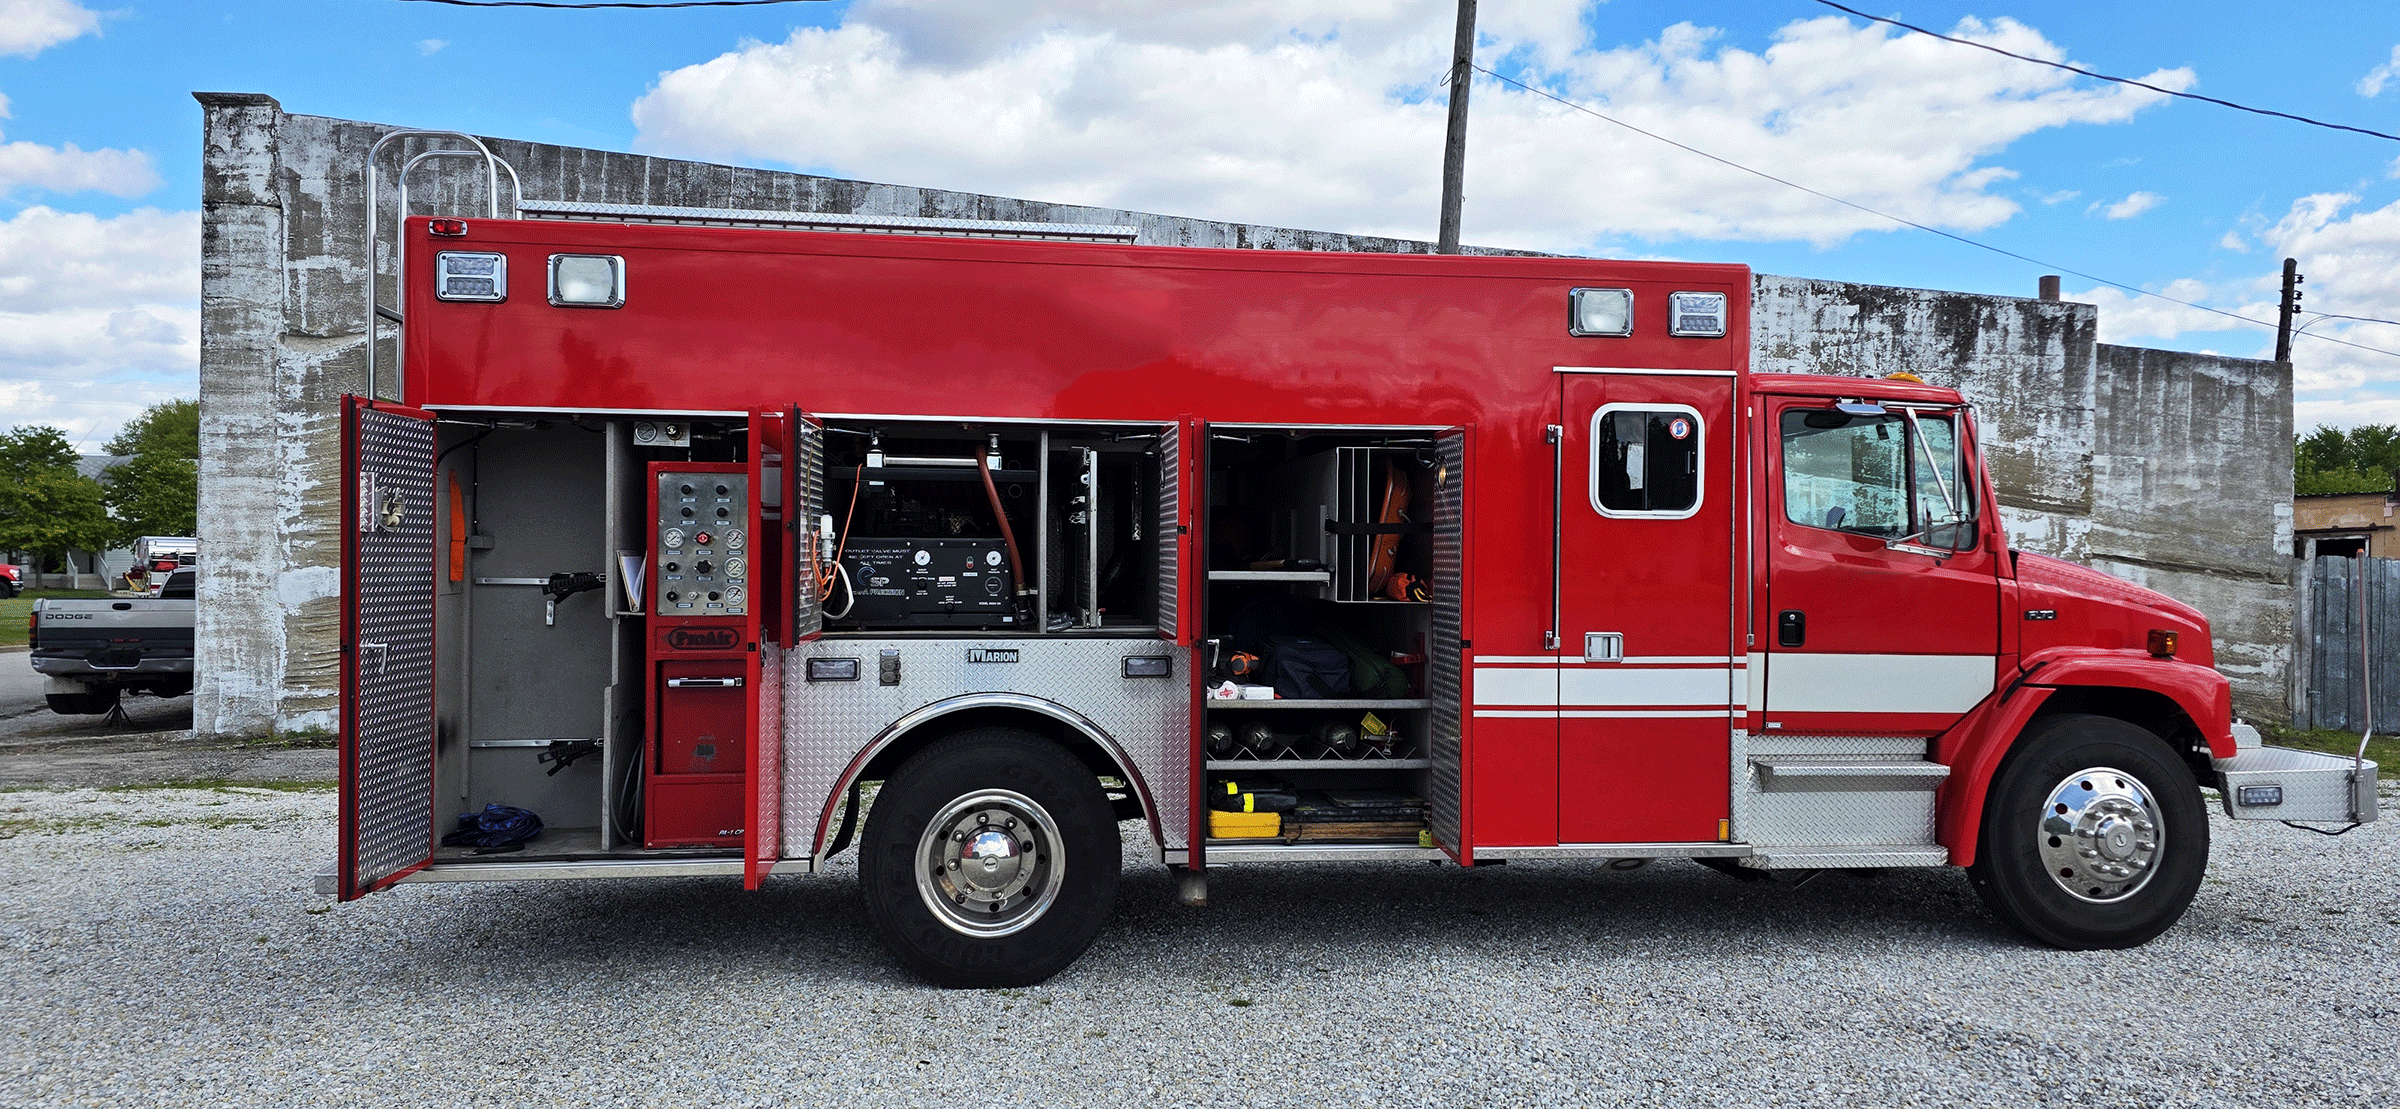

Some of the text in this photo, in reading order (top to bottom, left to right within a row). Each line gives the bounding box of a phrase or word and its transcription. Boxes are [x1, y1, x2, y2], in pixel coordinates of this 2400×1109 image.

[869, 576, 890, 588] SP
[674, 630, 734, 647] ProAir
[969, 649, 1018, 662] MARION
